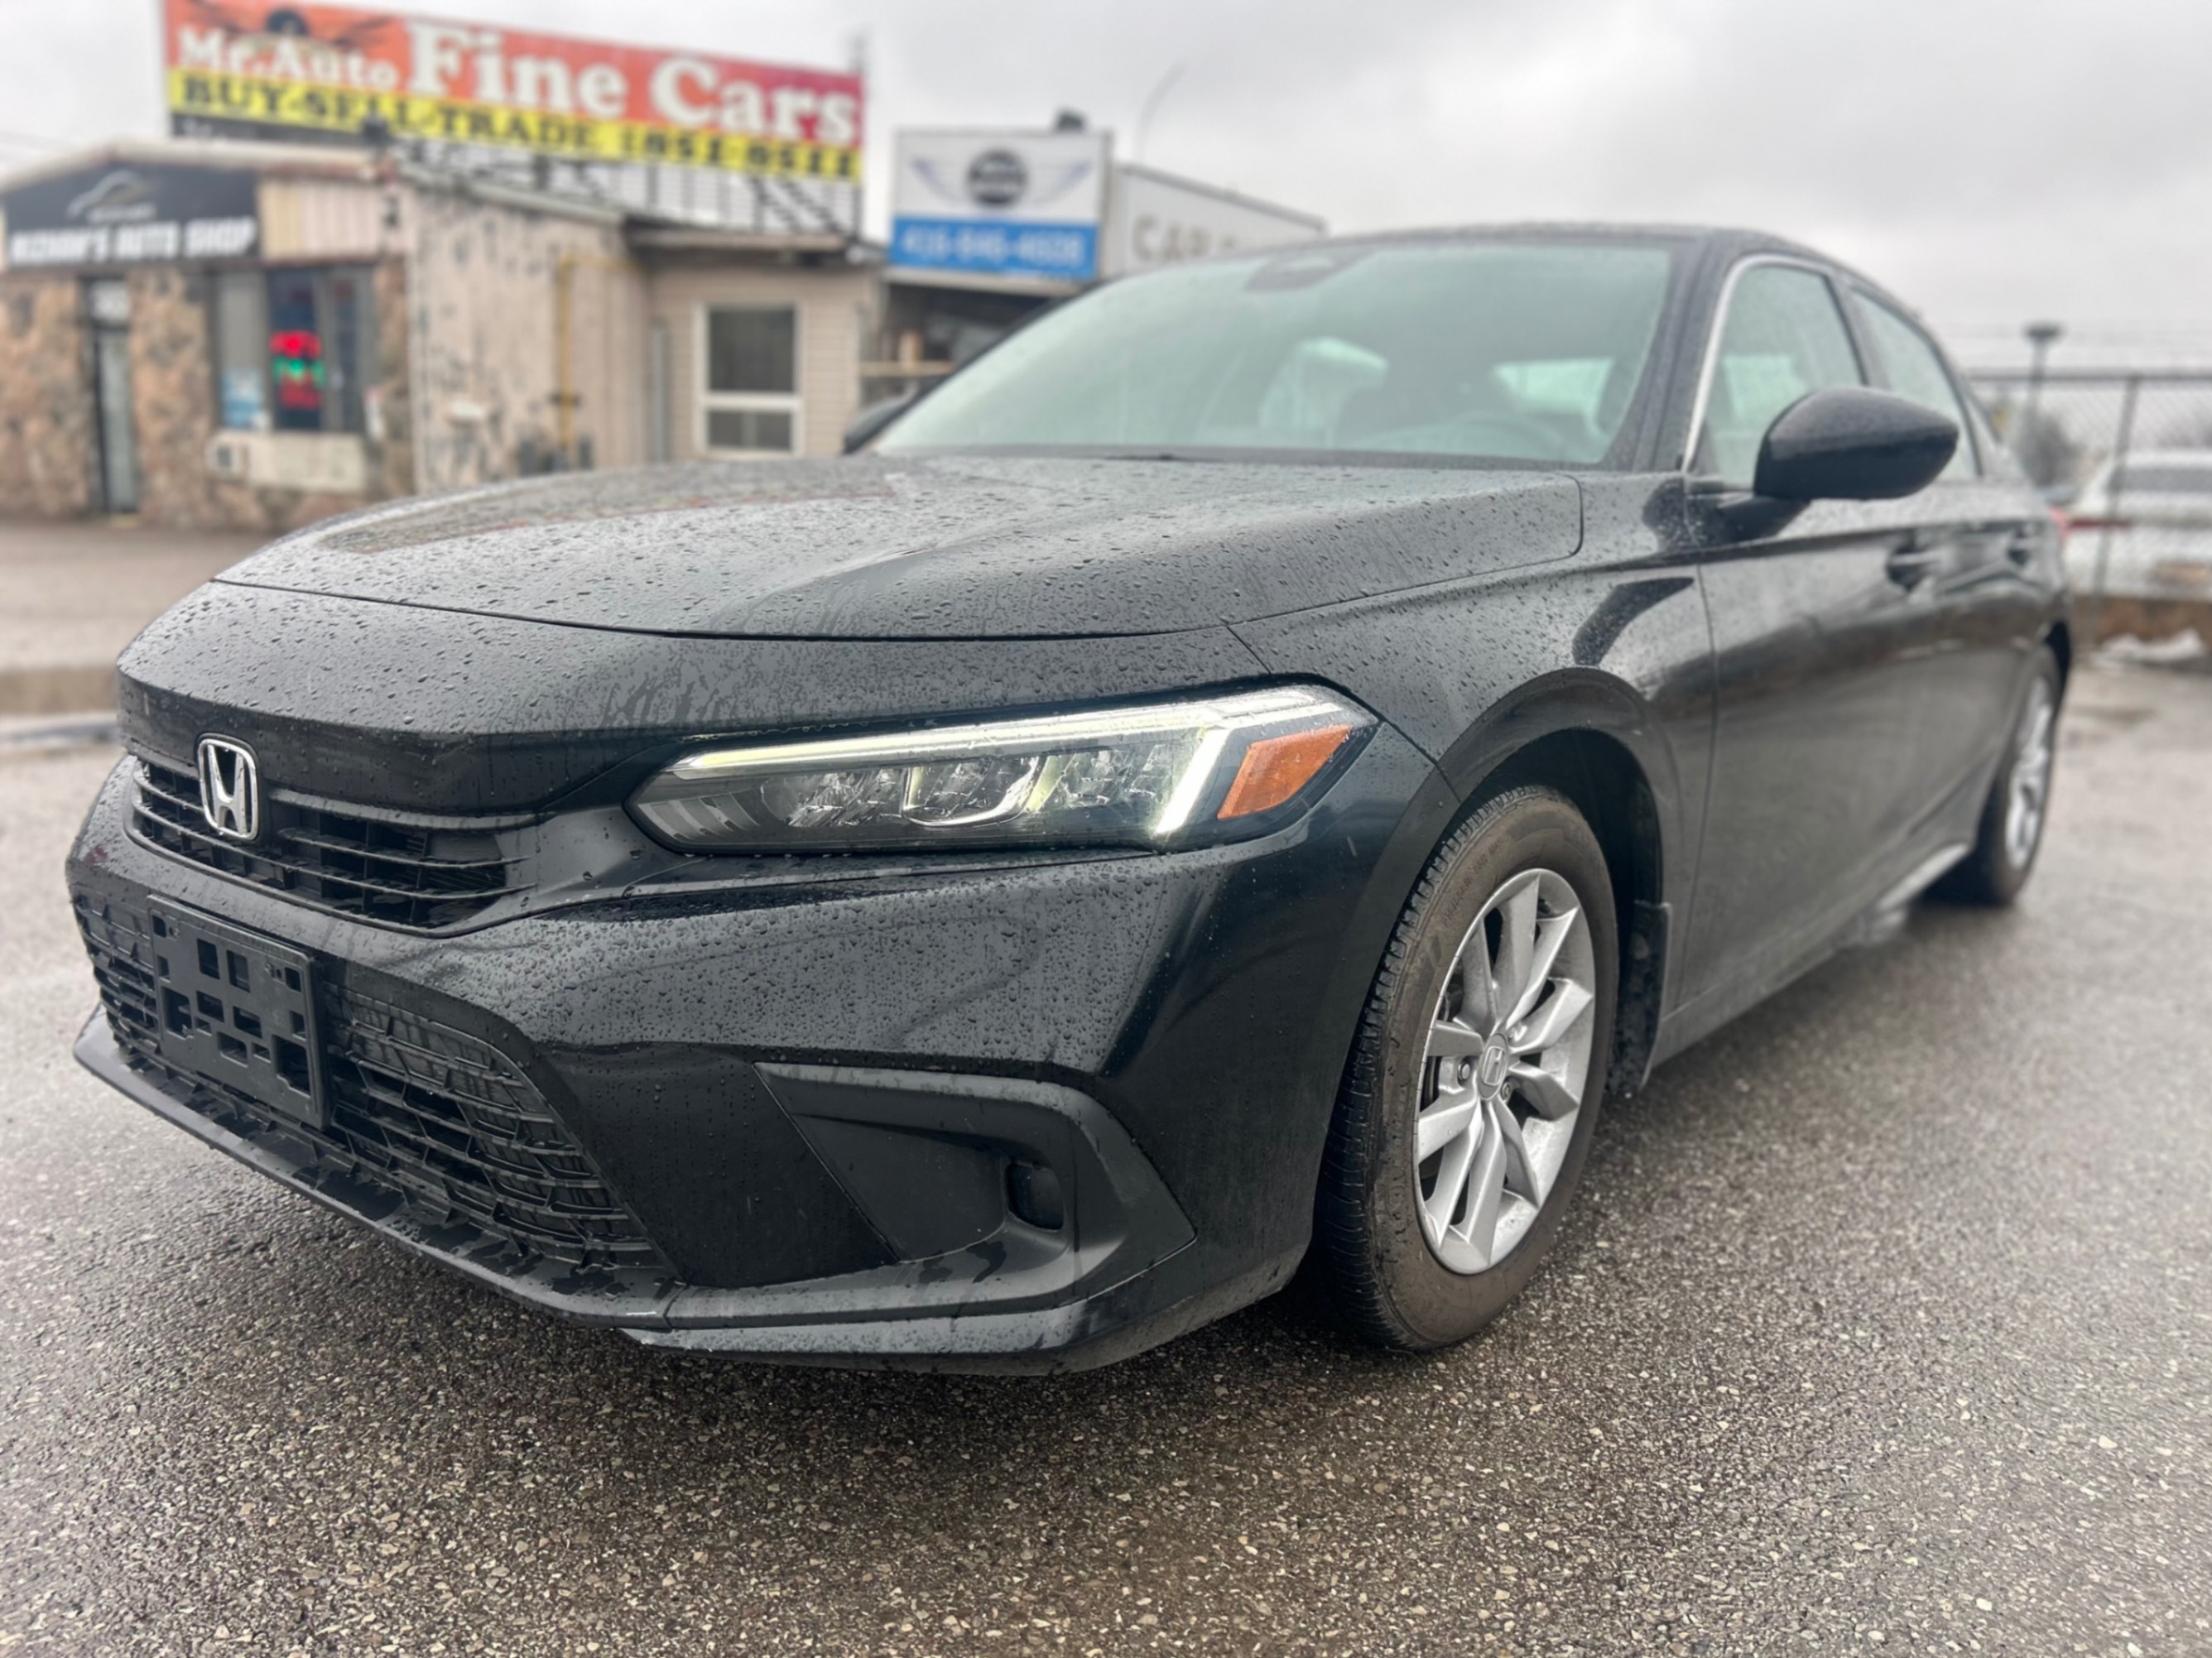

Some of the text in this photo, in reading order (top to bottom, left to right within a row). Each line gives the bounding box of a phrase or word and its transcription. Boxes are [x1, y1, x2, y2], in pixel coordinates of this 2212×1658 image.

[405, 25, 629, 118] Fine
[649, 55, 858, 146] Cars
[184, 217, 258, 258] SHOP
